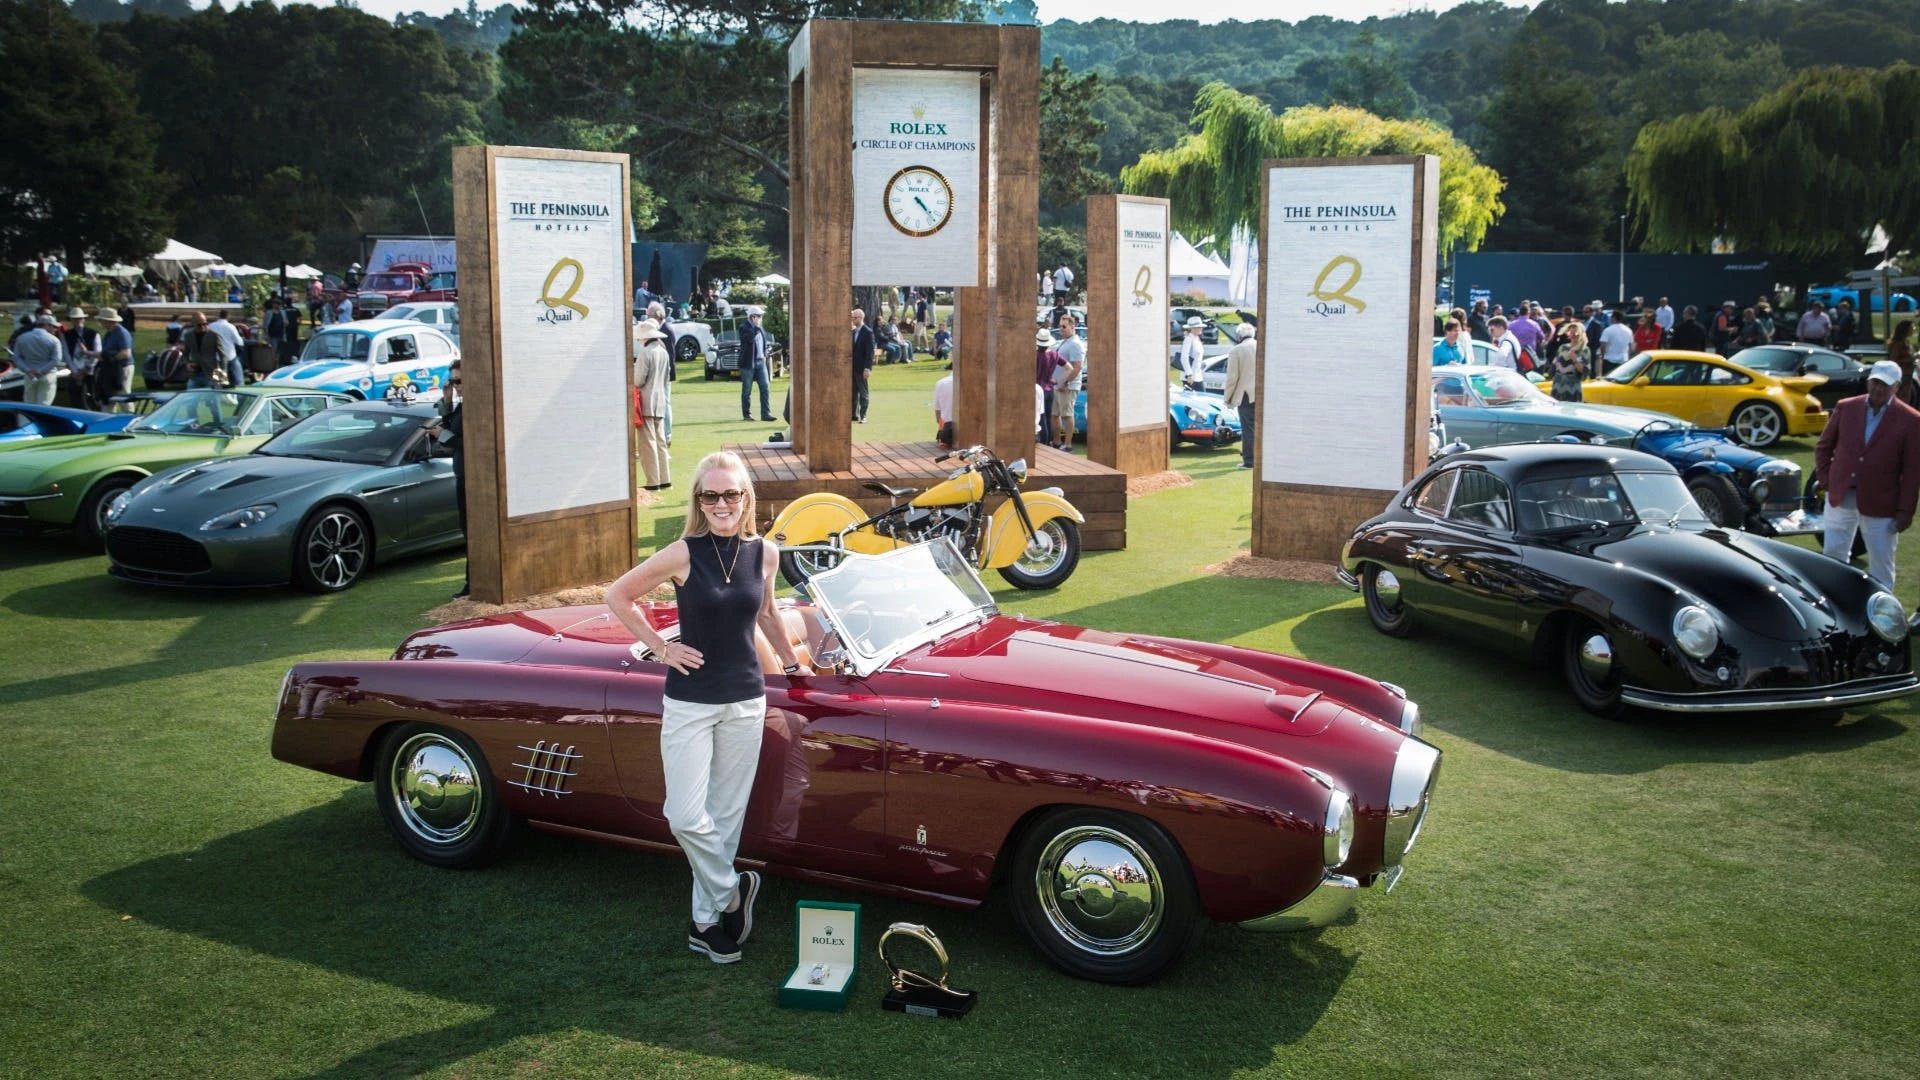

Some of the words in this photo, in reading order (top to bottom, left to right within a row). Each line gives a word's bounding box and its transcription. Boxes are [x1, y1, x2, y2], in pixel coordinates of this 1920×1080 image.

[889, 122, 948, 136] ROLEX
[860, 139, 897, 149] CIRCLE
[898, 140, 913, 150] OF
[914, 141, 976, 152] CHAMPIONS
[509, 202, 536, 215] THE
[541, 203, 610, 217] PENINSULA
[1283, 206, 1312, 218] THE
[1316, 205, 1397, 217] PENINSULA
[397, 254, 457, 266] CULLIN
[1316, 302, 1346, 317] Quail
[545, 308, 572, 325] Quail
[811, 936, 846, 946] ROLEX
